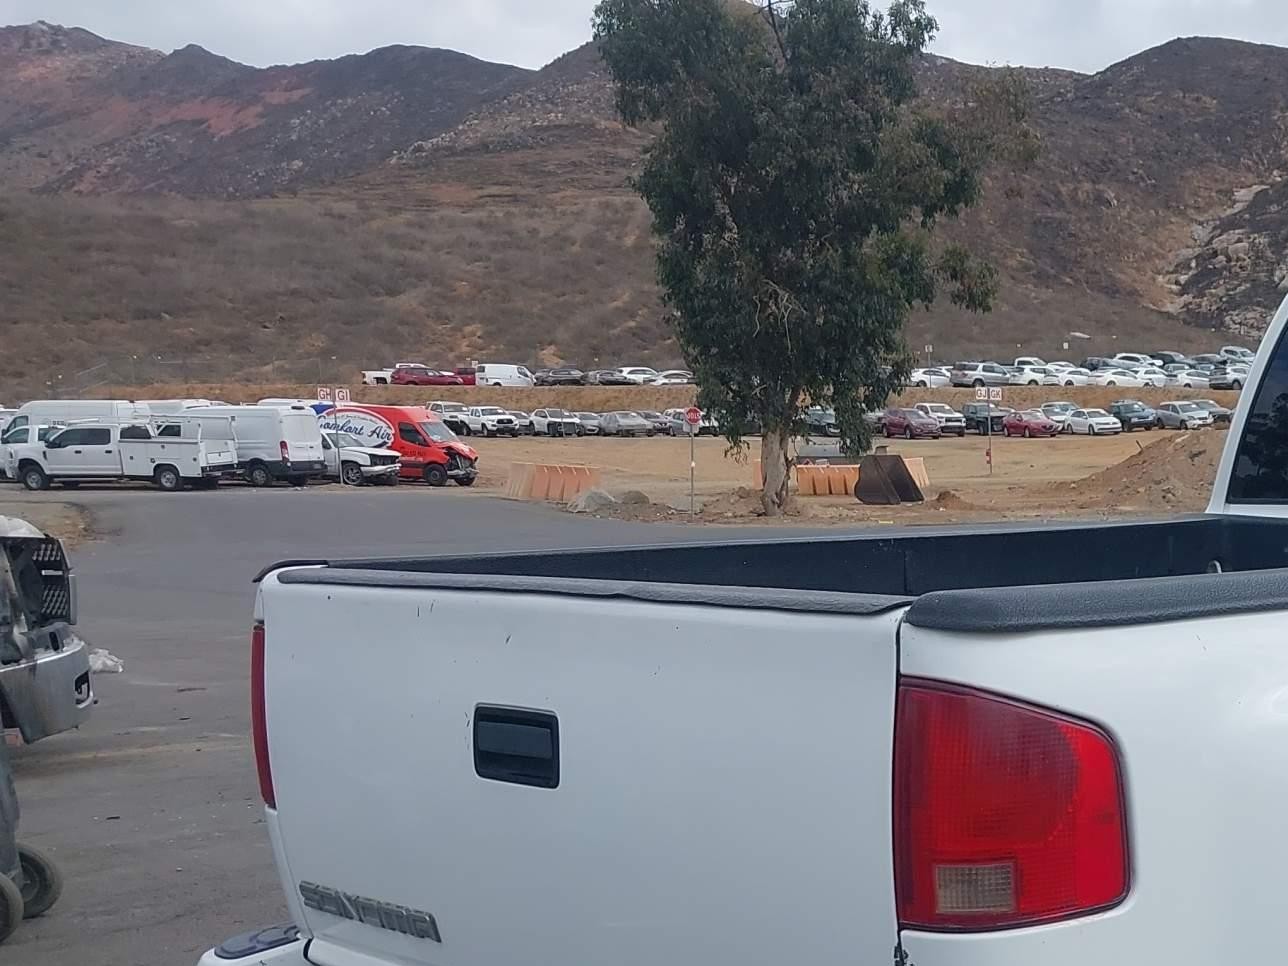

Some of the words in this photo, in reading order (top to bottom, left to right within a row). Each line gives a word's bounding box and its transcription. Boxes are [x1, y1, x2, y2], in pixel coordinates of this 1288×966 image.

[319, 389, 331, 400] GH
[337, 390, 348, 401] GI
[367, 425, 392, 441] Air
